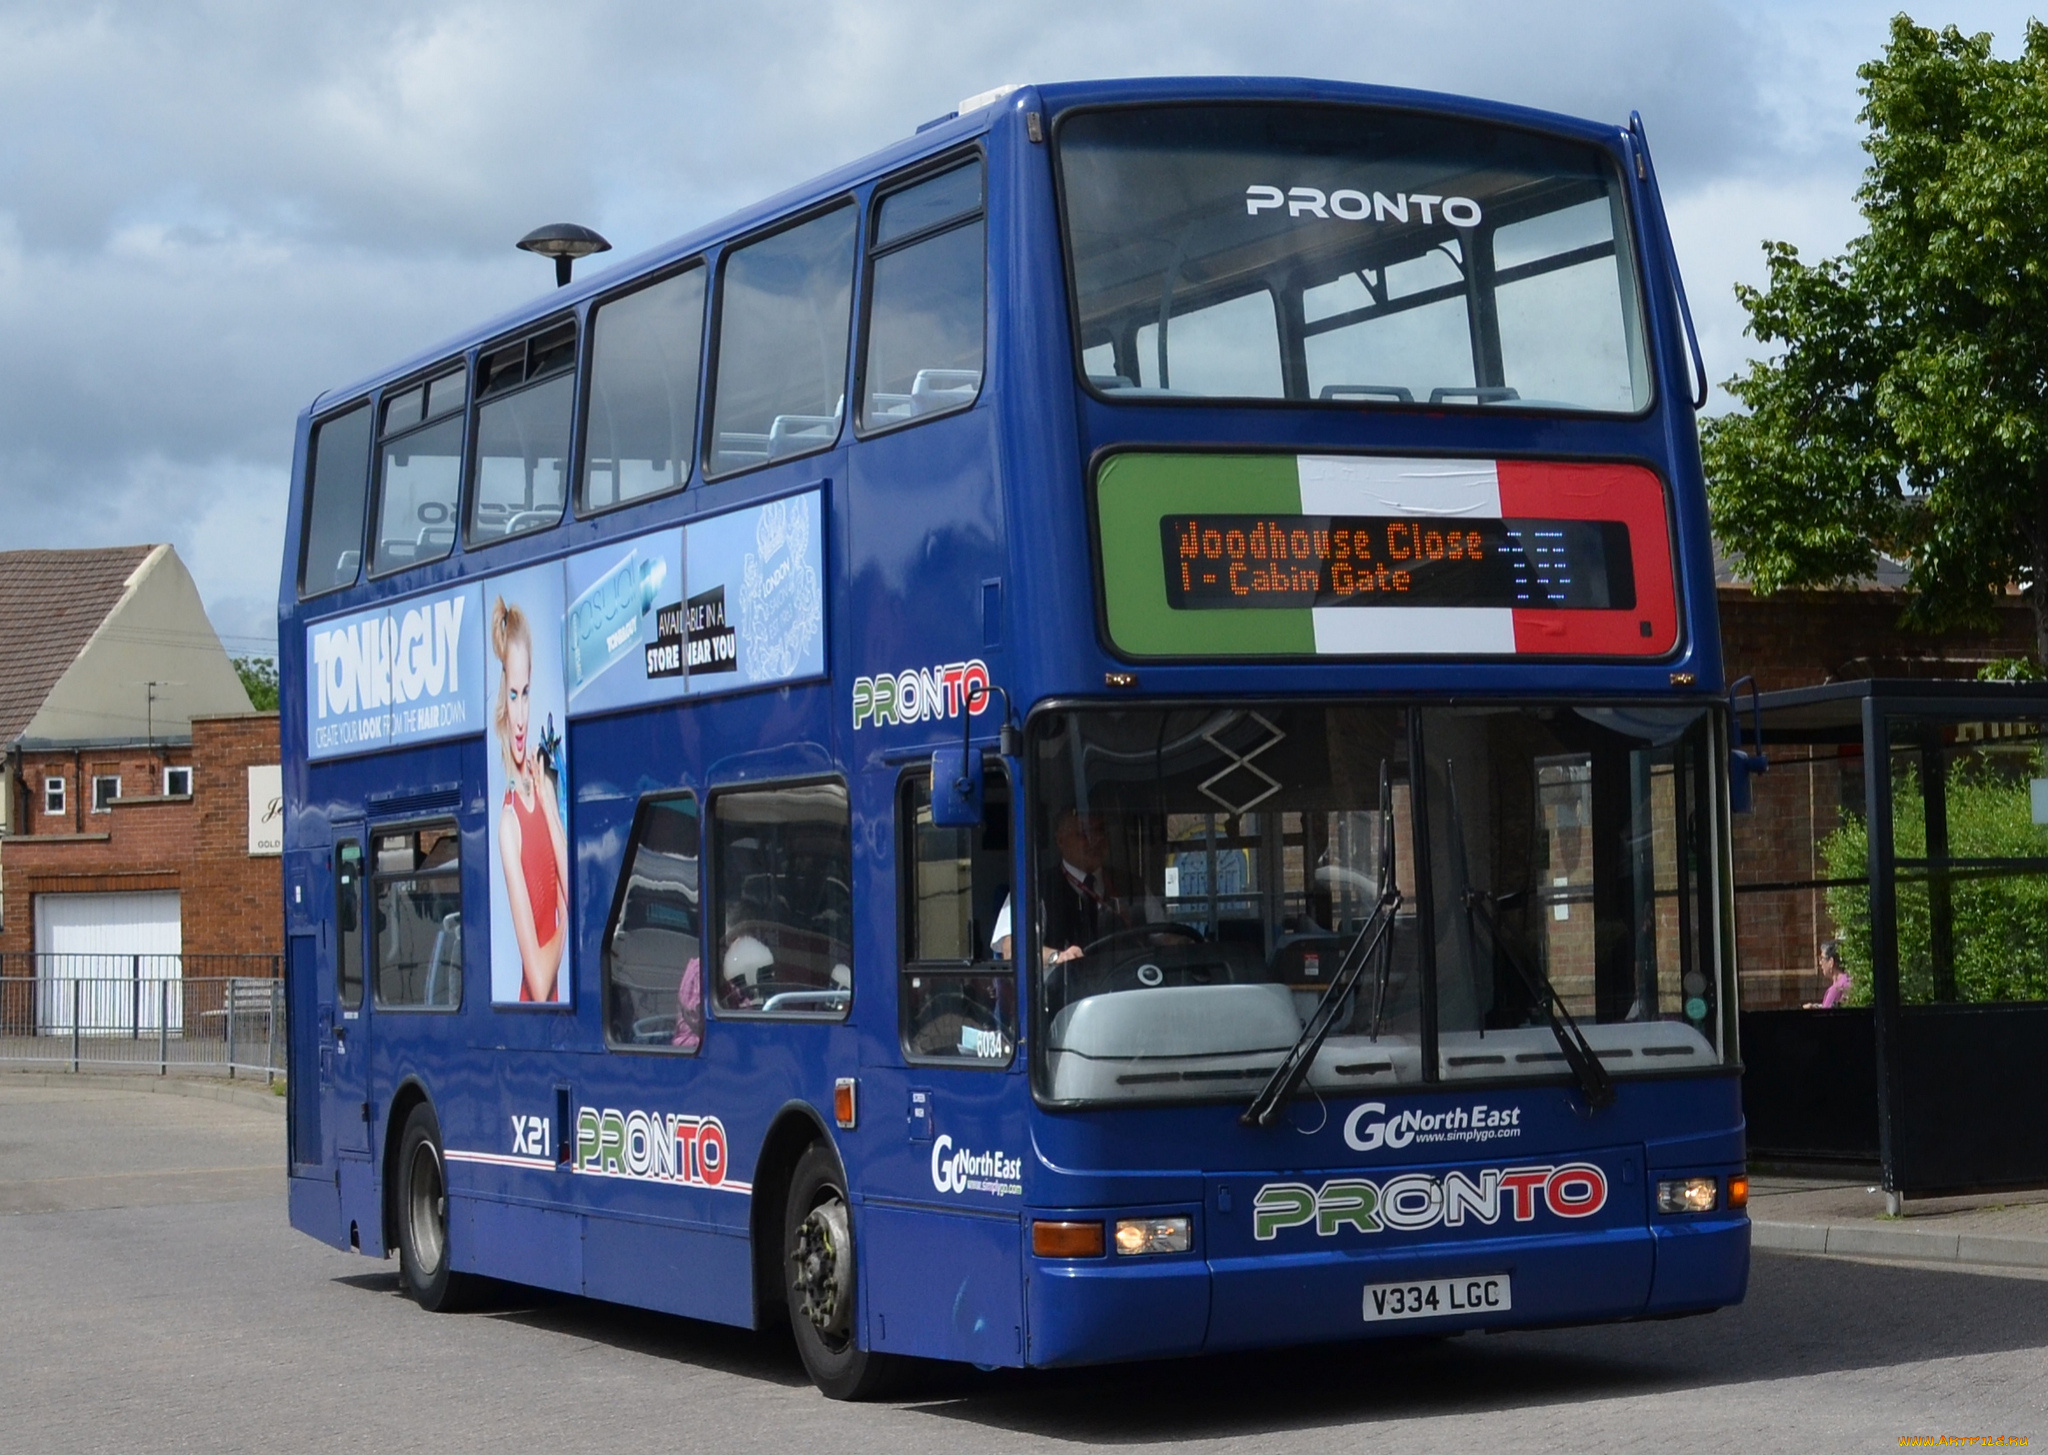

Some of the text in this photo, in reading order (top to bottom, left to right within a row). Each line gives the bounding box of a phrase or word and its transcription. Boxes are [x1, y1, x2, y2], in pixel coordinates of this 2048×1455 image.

[1246, 185, 1482, 227] PRONTO
[1178, 521, 1482, 559] Woodhouse Close
[762, 557, 791, 598] LONDON
[1229, 562, 1320, 595] Cabin
[1331, 562, 1411, 595] Gate
[658, 601, 725, 638] AVAILABLE IN A
[314, 596, 466, 719] TONI&GUY
[647, 644, 680, 674] STORE
[712, 633, 736, 661] YOU
[853, 659, 990, 730] PRONTO
[315, 699, 466, 748] CREATE YOUR LOOK FROM THE HAIR DOWN
[258, 840, 281, 848] GOLD
[976, 1031, 1002, 1058] 6034
[511, 1115, 550, 1156] X21
[1415, 1128, 1521, 1143] www.simplygo.com
[1471, 1105, 1521, 1128] East
[577, 1106, 728, 1186] PRONTO
[994, 1151, 1021, 1180] East
[967, 1178, 1022, 1196] www.simplygo.com
[1253, 1162, 1608, 1240] PRONTO
[1372, 1281, 1500, 1315] V334 LGC
